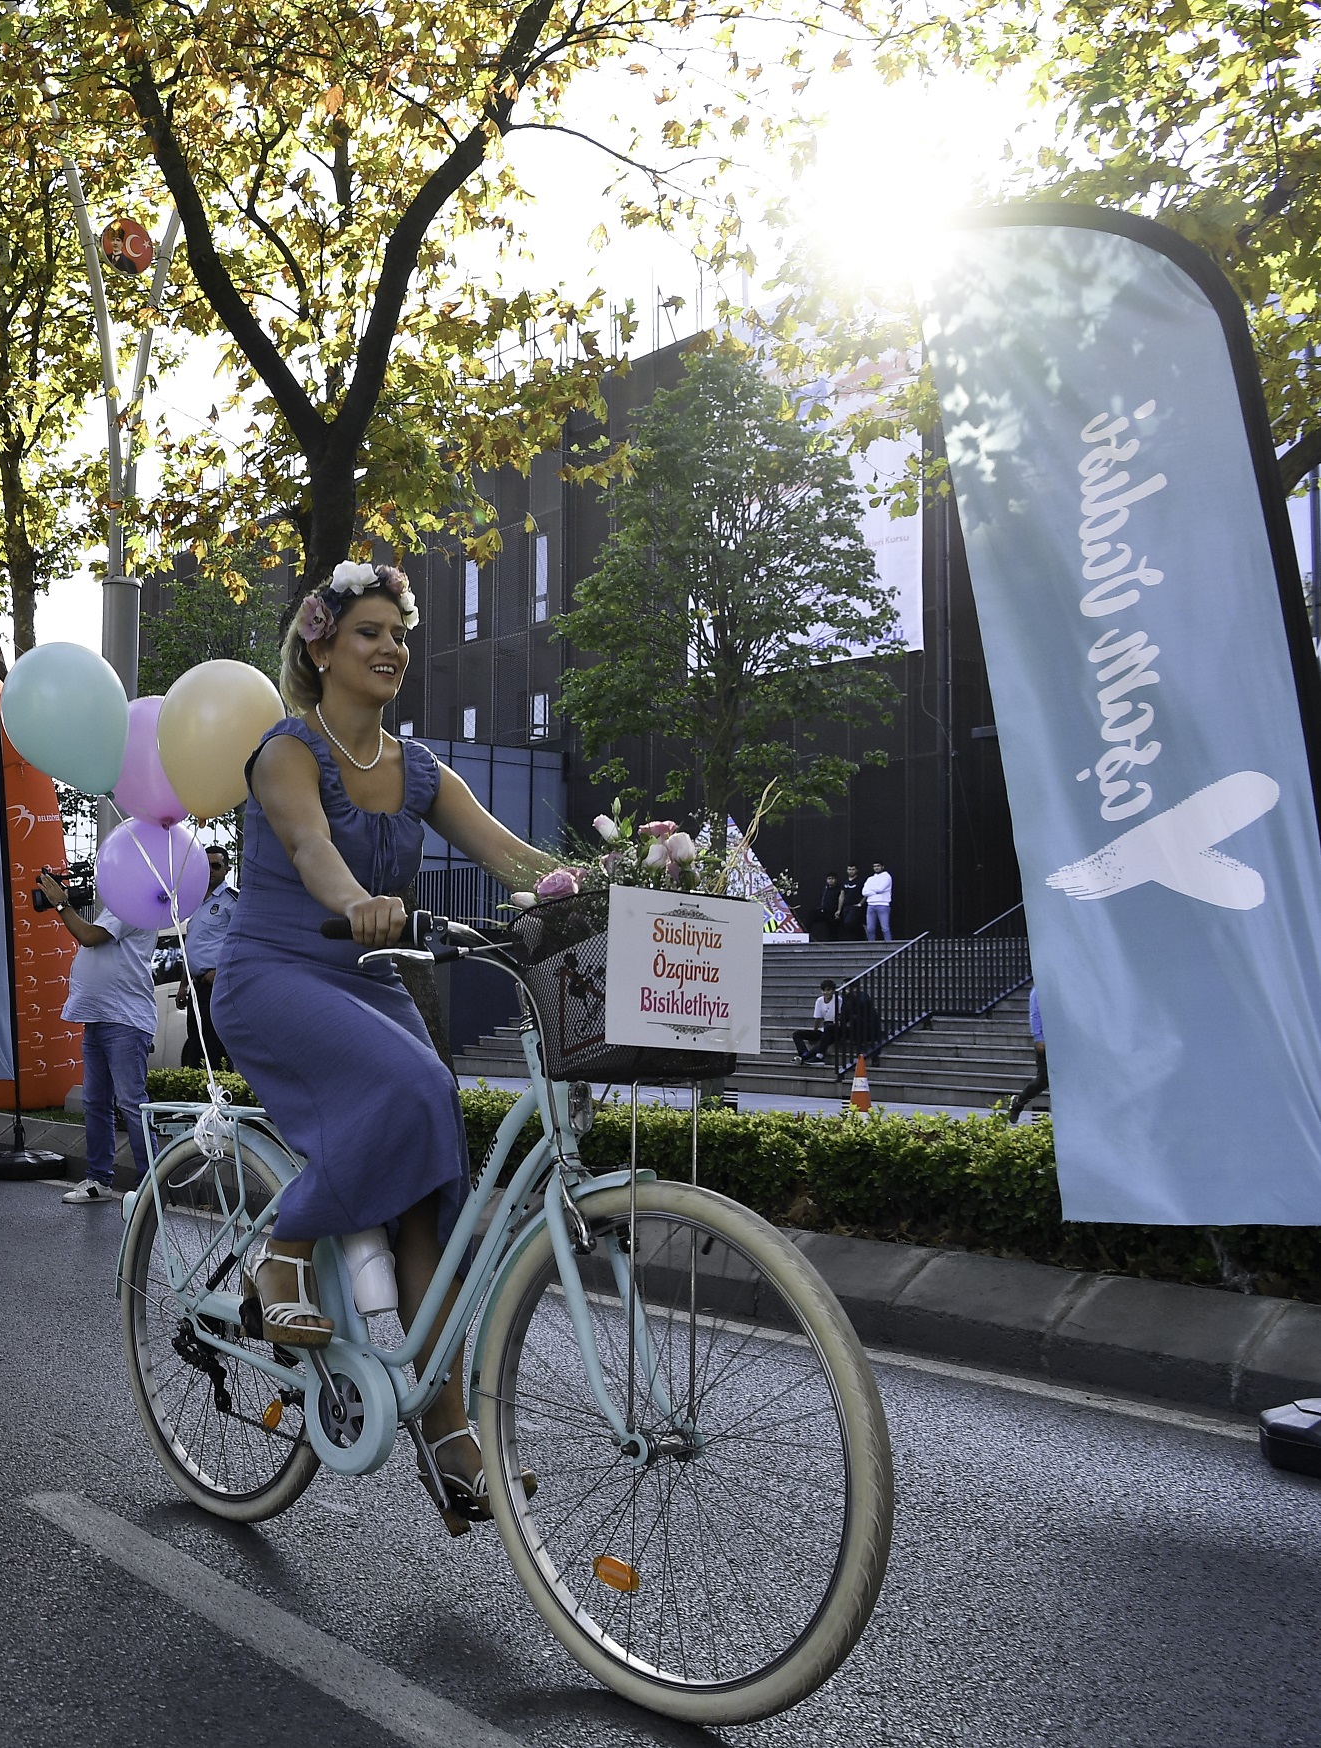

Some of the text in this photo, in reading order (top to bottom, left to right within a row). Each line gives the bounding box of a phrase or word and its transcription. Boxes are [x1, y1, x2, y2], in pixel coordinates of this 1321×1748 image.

[652, 918, 723, 955] Süslüyüz
[653, 949, 720, 989] Özgürüz
[640, 986, 729, 1025] Bisikletliyiz
